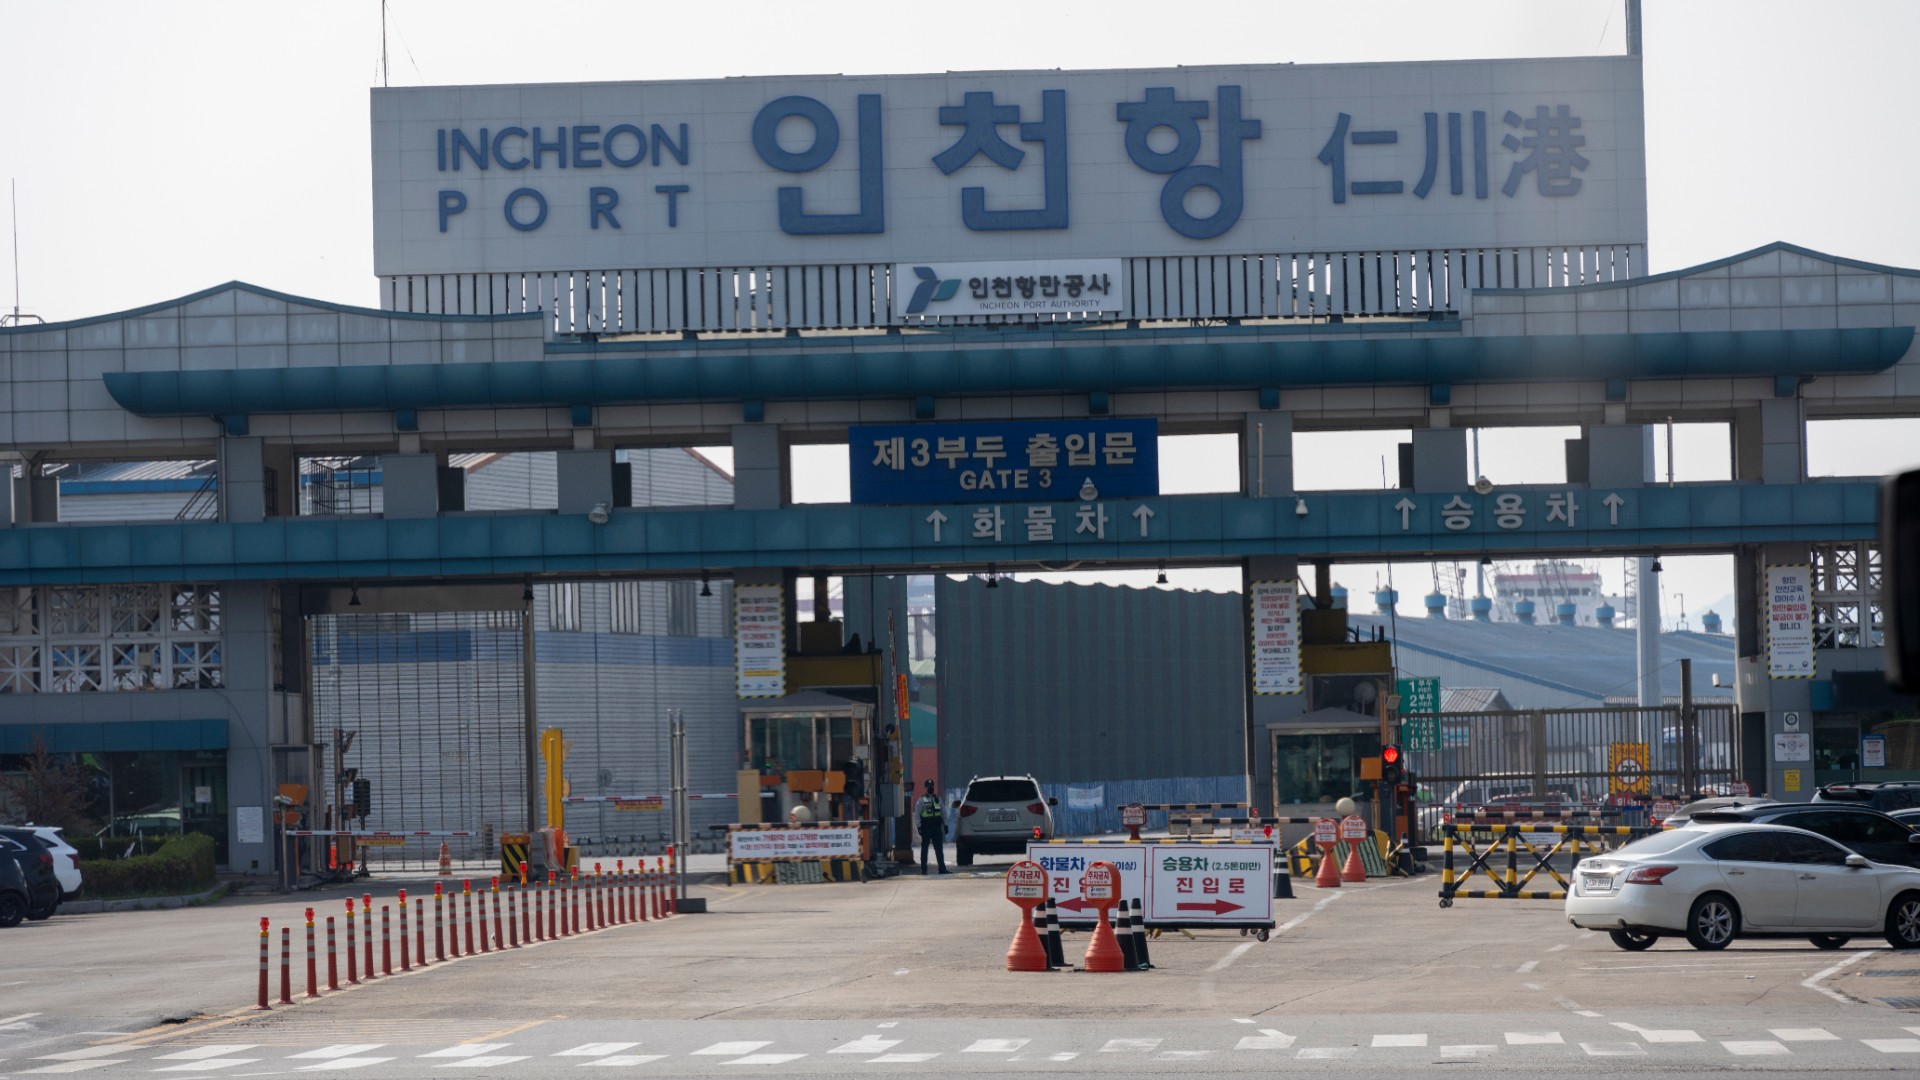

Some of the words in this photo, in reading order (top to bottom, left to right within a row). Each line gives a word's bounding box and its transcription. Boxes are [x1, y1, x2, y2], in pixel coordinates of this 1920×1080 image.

[437, 122, 690, 172] INCHEON
[1317, 105, 1591, 204] 仁川港
[752, 85, 1261, 240] 인천항
[438, 184, 690, 233] PORT
[968, 273, 1111, 299] 인천항만공사
[979, 301, 1020, 310] INCHEON
[1023, 300, 1047, 309] PORT
[1050, 299, 1101, 308] AUTHORITY
[873, 435, 1007, 471] 제3부두
[1025, 431, 1137, 467] 출입문
[959, 469, 1029, 490] GATE
[1039, 469, 1052, 489] 3
[972, 503, 1108, 541] 화물차
[1441, 491, 1579, 531] 승용차
[1409, 681, 1415, 693] 1
[1409, 695, 1417, 707] 2
[1040, 856, 1085, 871] 화물차
[1162, 856, 1209, 872] 승용차
[1212, 861, 1261, 871] (2.5톤미만)
[1176, 877, 1245, 894] 진입로
